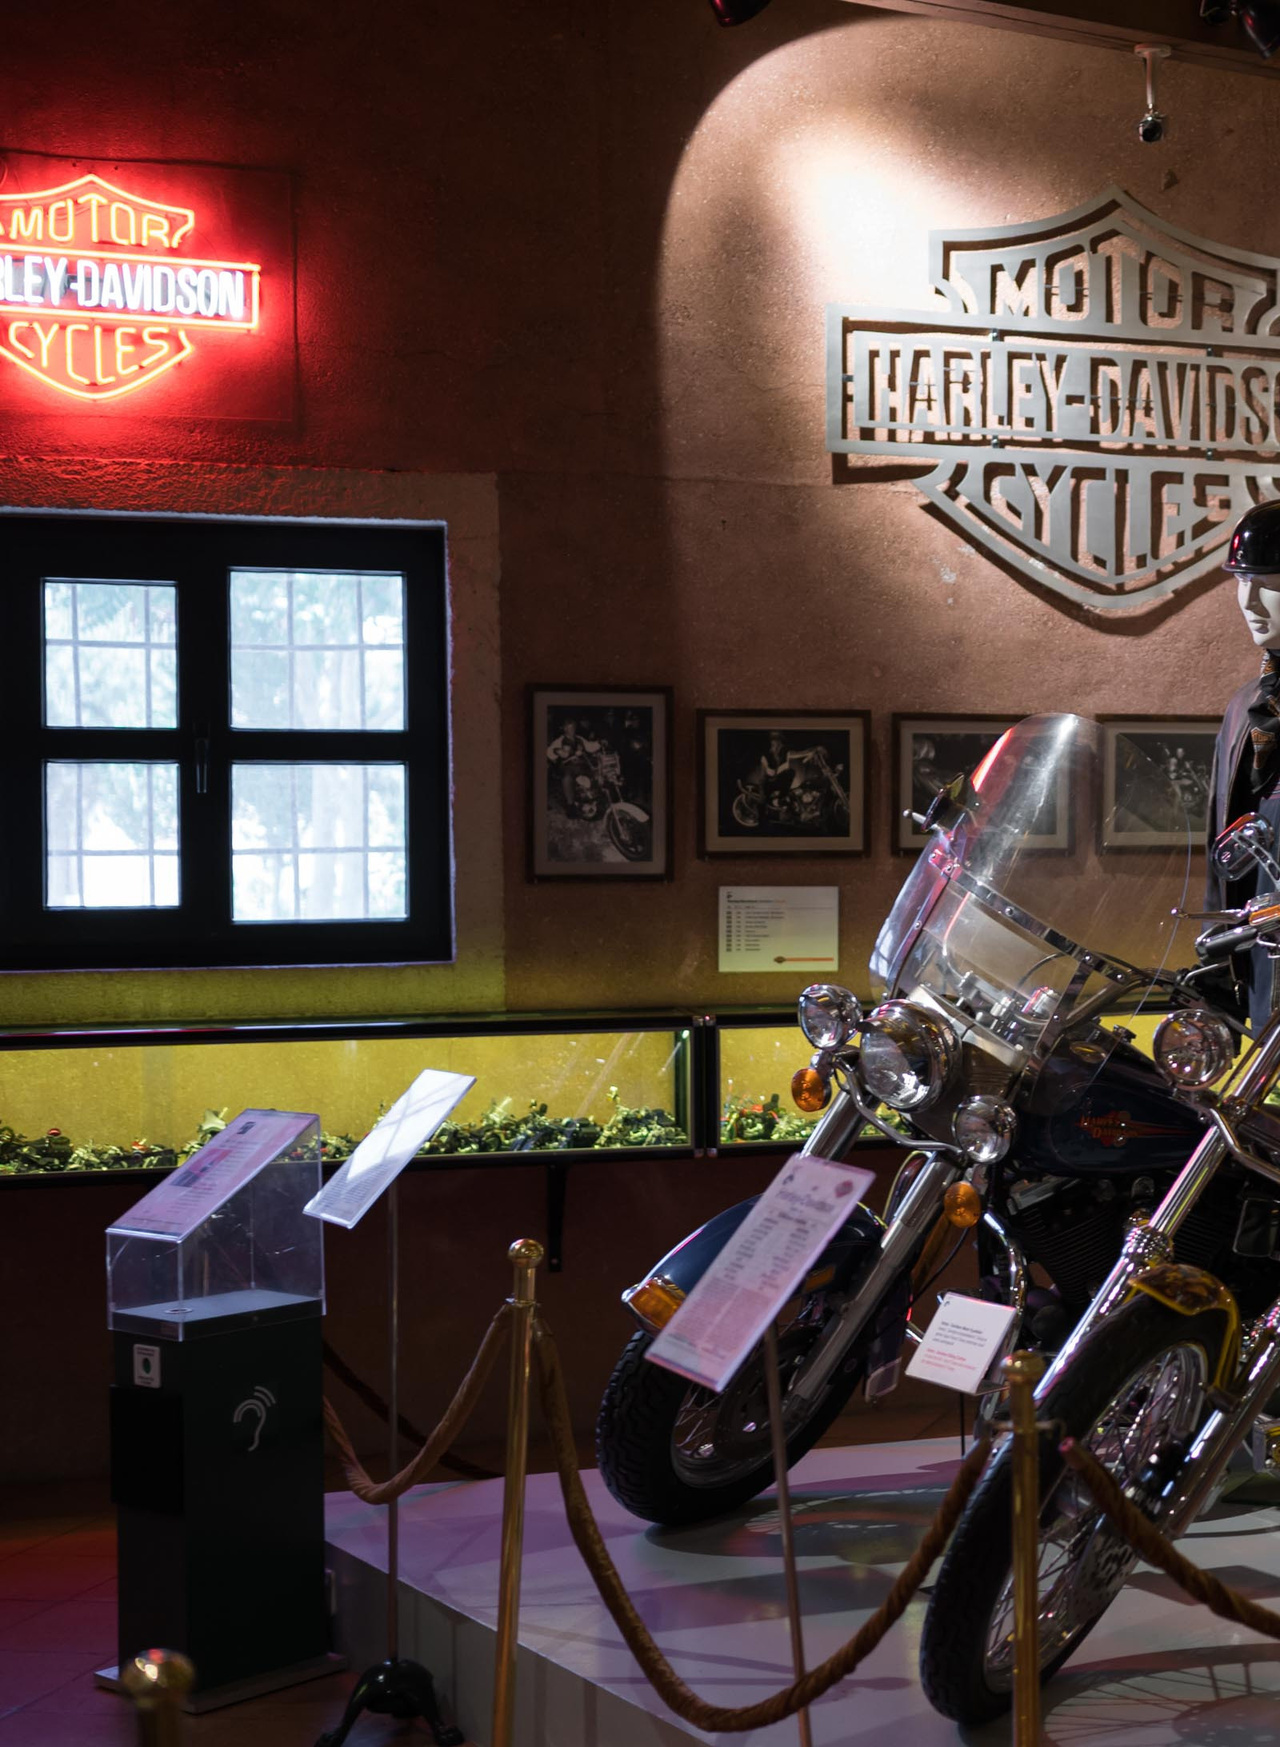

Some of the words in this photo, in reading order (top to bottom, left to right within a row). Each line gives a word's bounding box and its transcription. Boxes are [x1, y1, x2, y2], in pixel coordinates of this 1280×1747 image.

[9, 193, 171, 248] MOTOR
[0, 254, 245, 318] LEY-DAVIDSON
[989, 229, 1236, 333] MOTOR
[8, 321, 171, 386] CYCLES
[982, 461, 1232, 577] CYCLES
